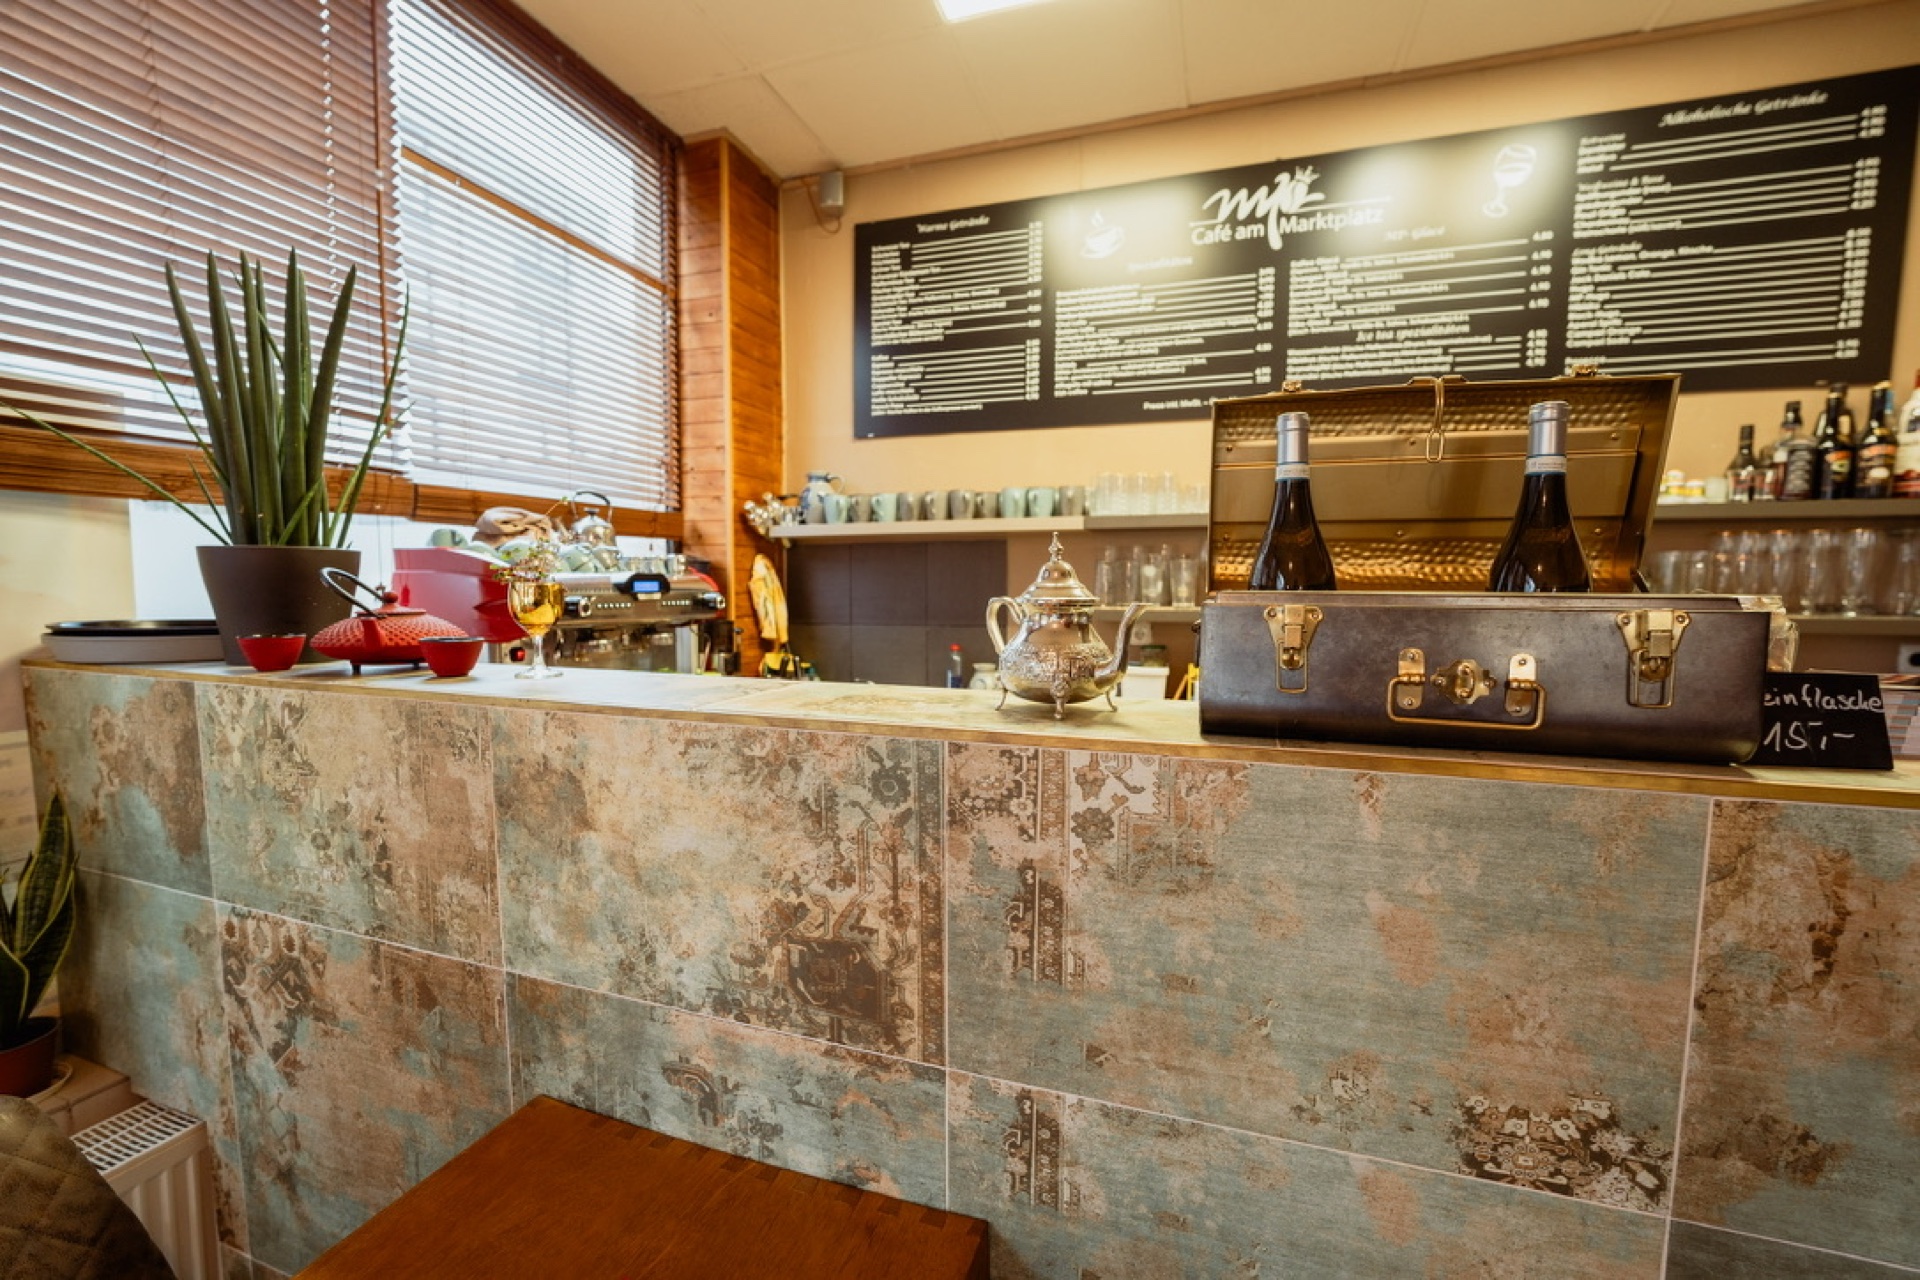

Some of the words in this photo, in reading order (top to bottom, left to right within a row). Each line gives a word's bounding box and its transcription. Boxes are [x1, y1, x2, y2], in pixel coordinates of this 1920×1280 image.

[1191, 223, 1232, 246] Café
[1235, 223, 1265, 241] am
[1280, 207, 1385, 235] Marktplatz
